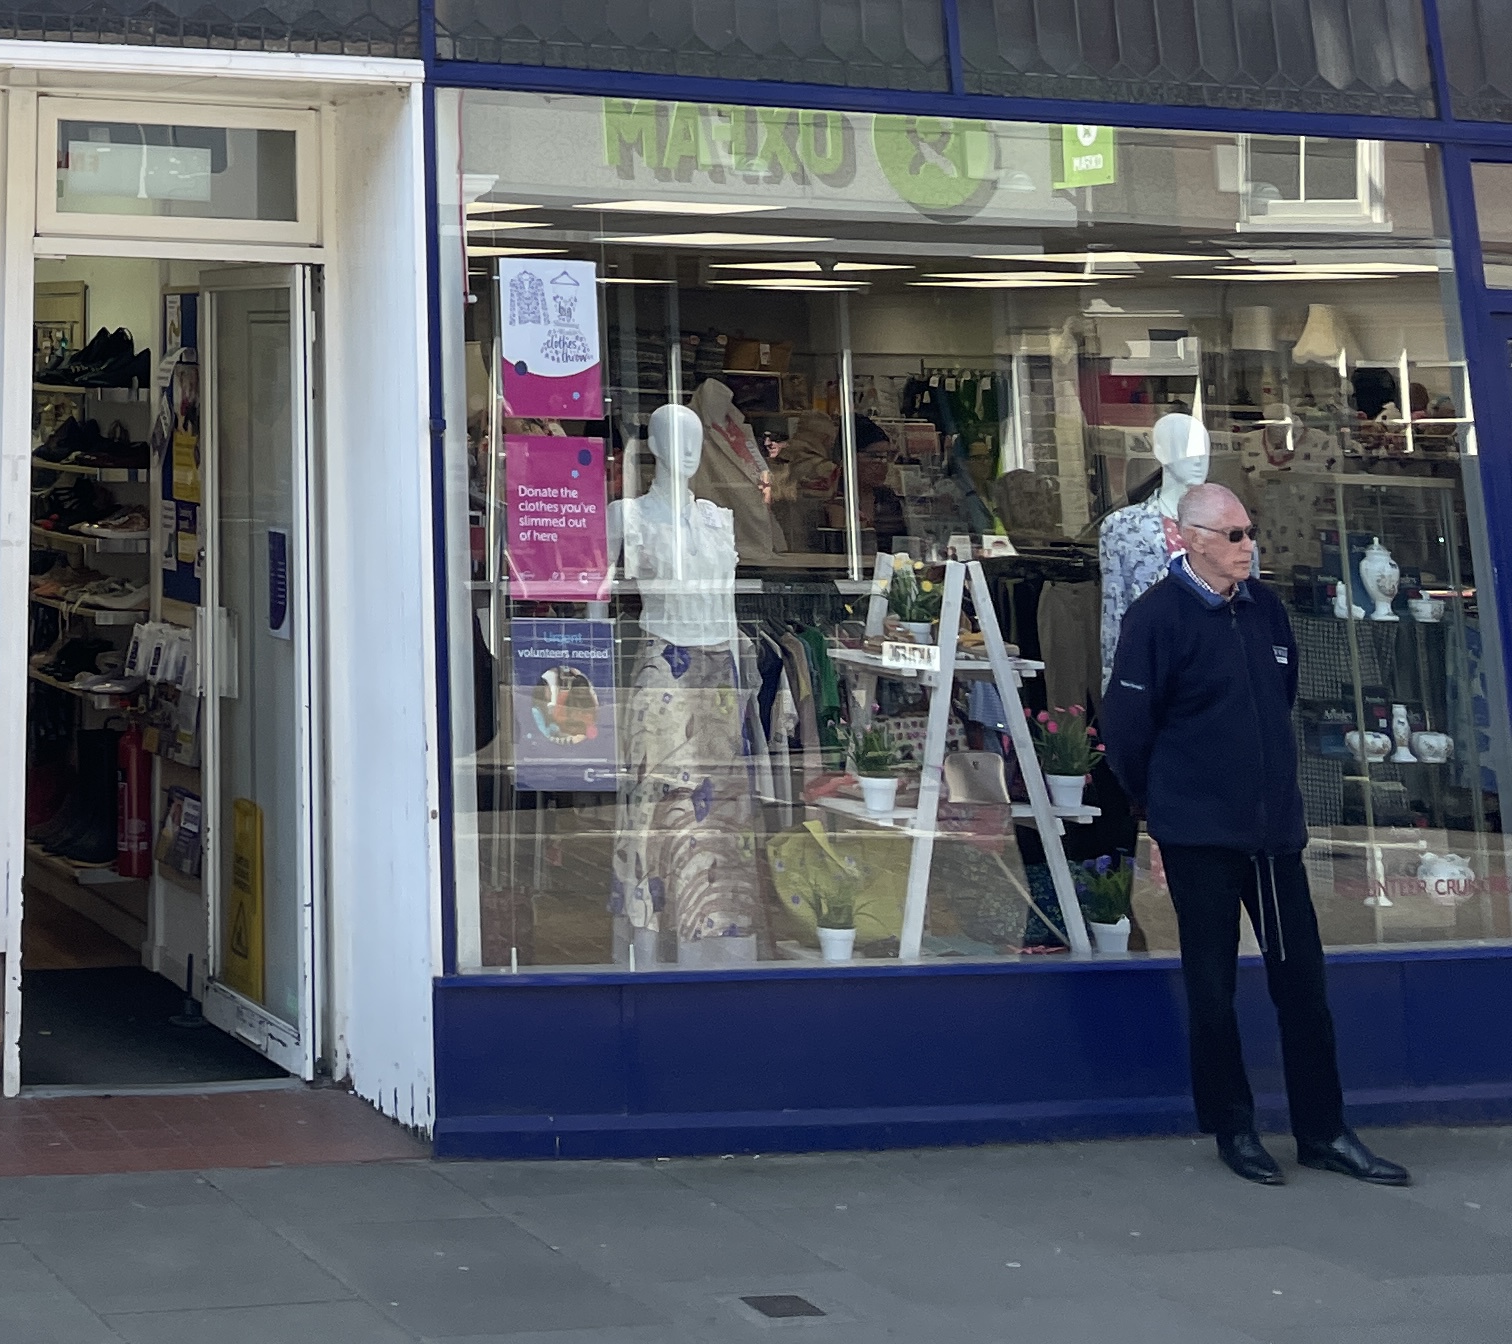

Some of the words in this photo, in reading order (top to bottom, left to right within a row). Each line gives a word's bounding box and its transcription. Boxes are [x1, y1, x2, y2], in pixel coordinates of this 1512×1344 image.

[518, 484, 558, 497] Donate
[560, 486, 579, 499] the
[518, 500, 558, 513] clothes
[519, 515, 566, 528] slimmed
[568, 518, 588, 529] out
[519, 530, 532, 542] of
[533, 530, 559, 543] here
[518, 647, 570, 659] volunteers
